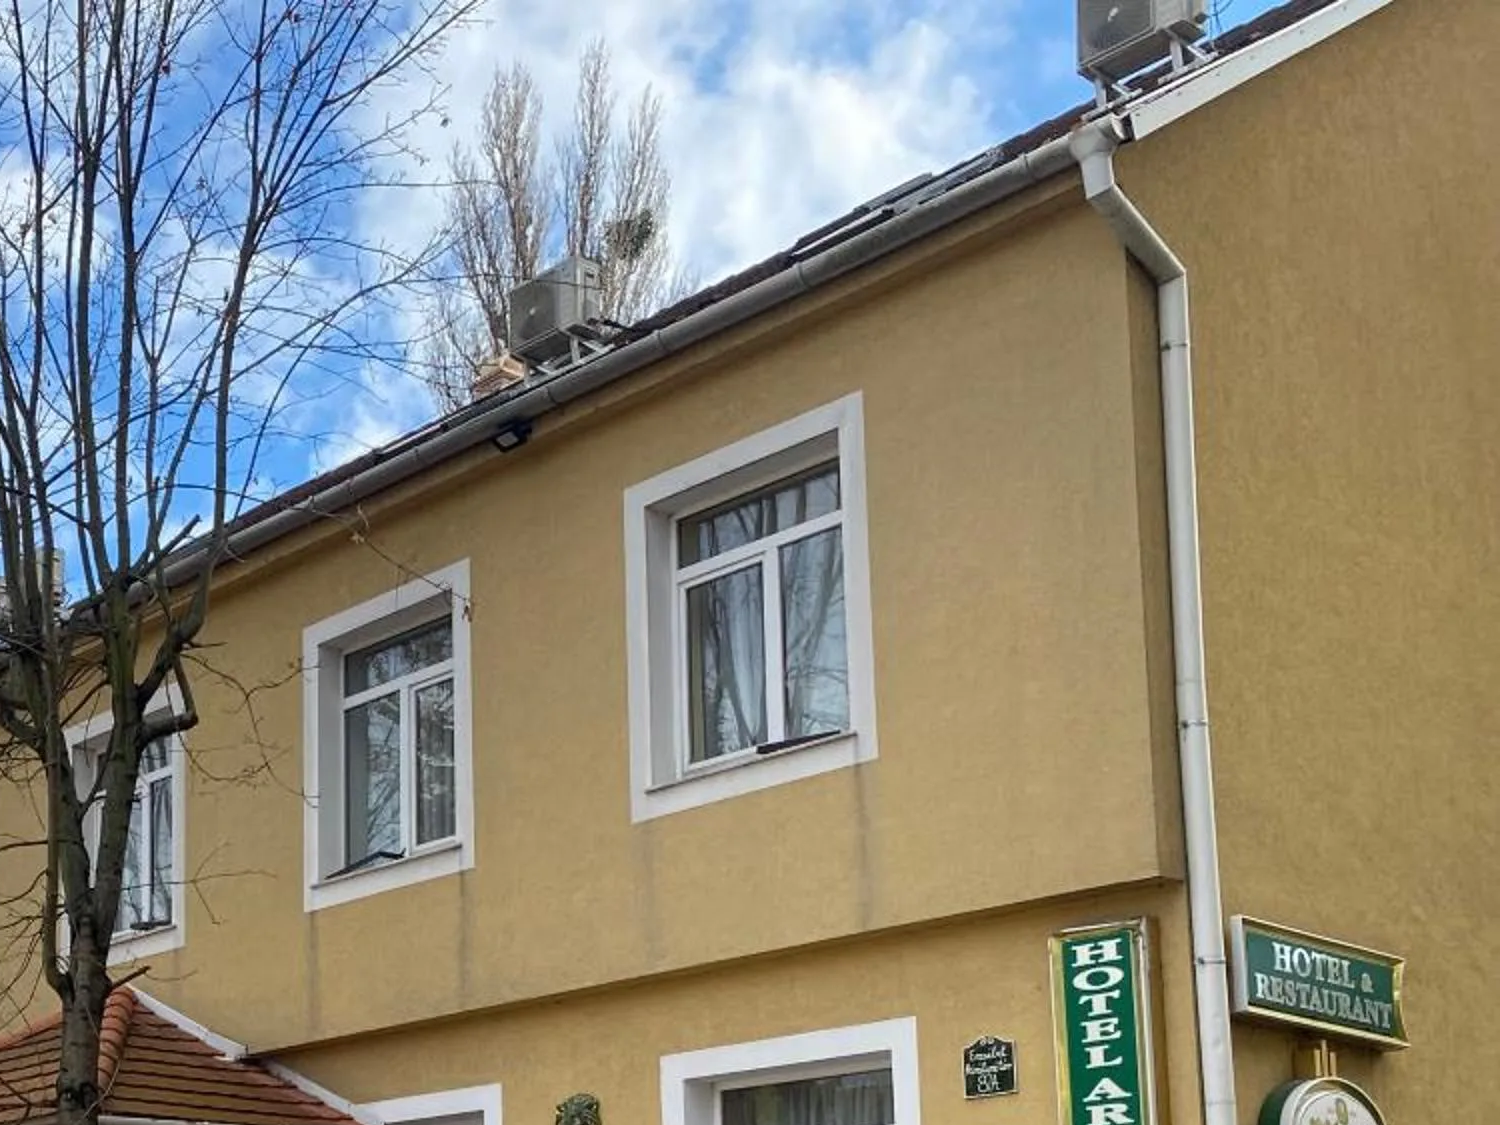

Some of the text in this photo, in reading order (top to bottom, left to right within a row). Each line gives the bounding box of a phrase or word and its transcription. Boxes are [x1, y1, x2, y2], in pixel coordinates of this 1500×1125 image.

[1272, 942, 1355, 988] HOTEL
[1071, 938, 1124, 1069] HOTEL
[1254, 972, 1392, 1028] RESTAURANT
